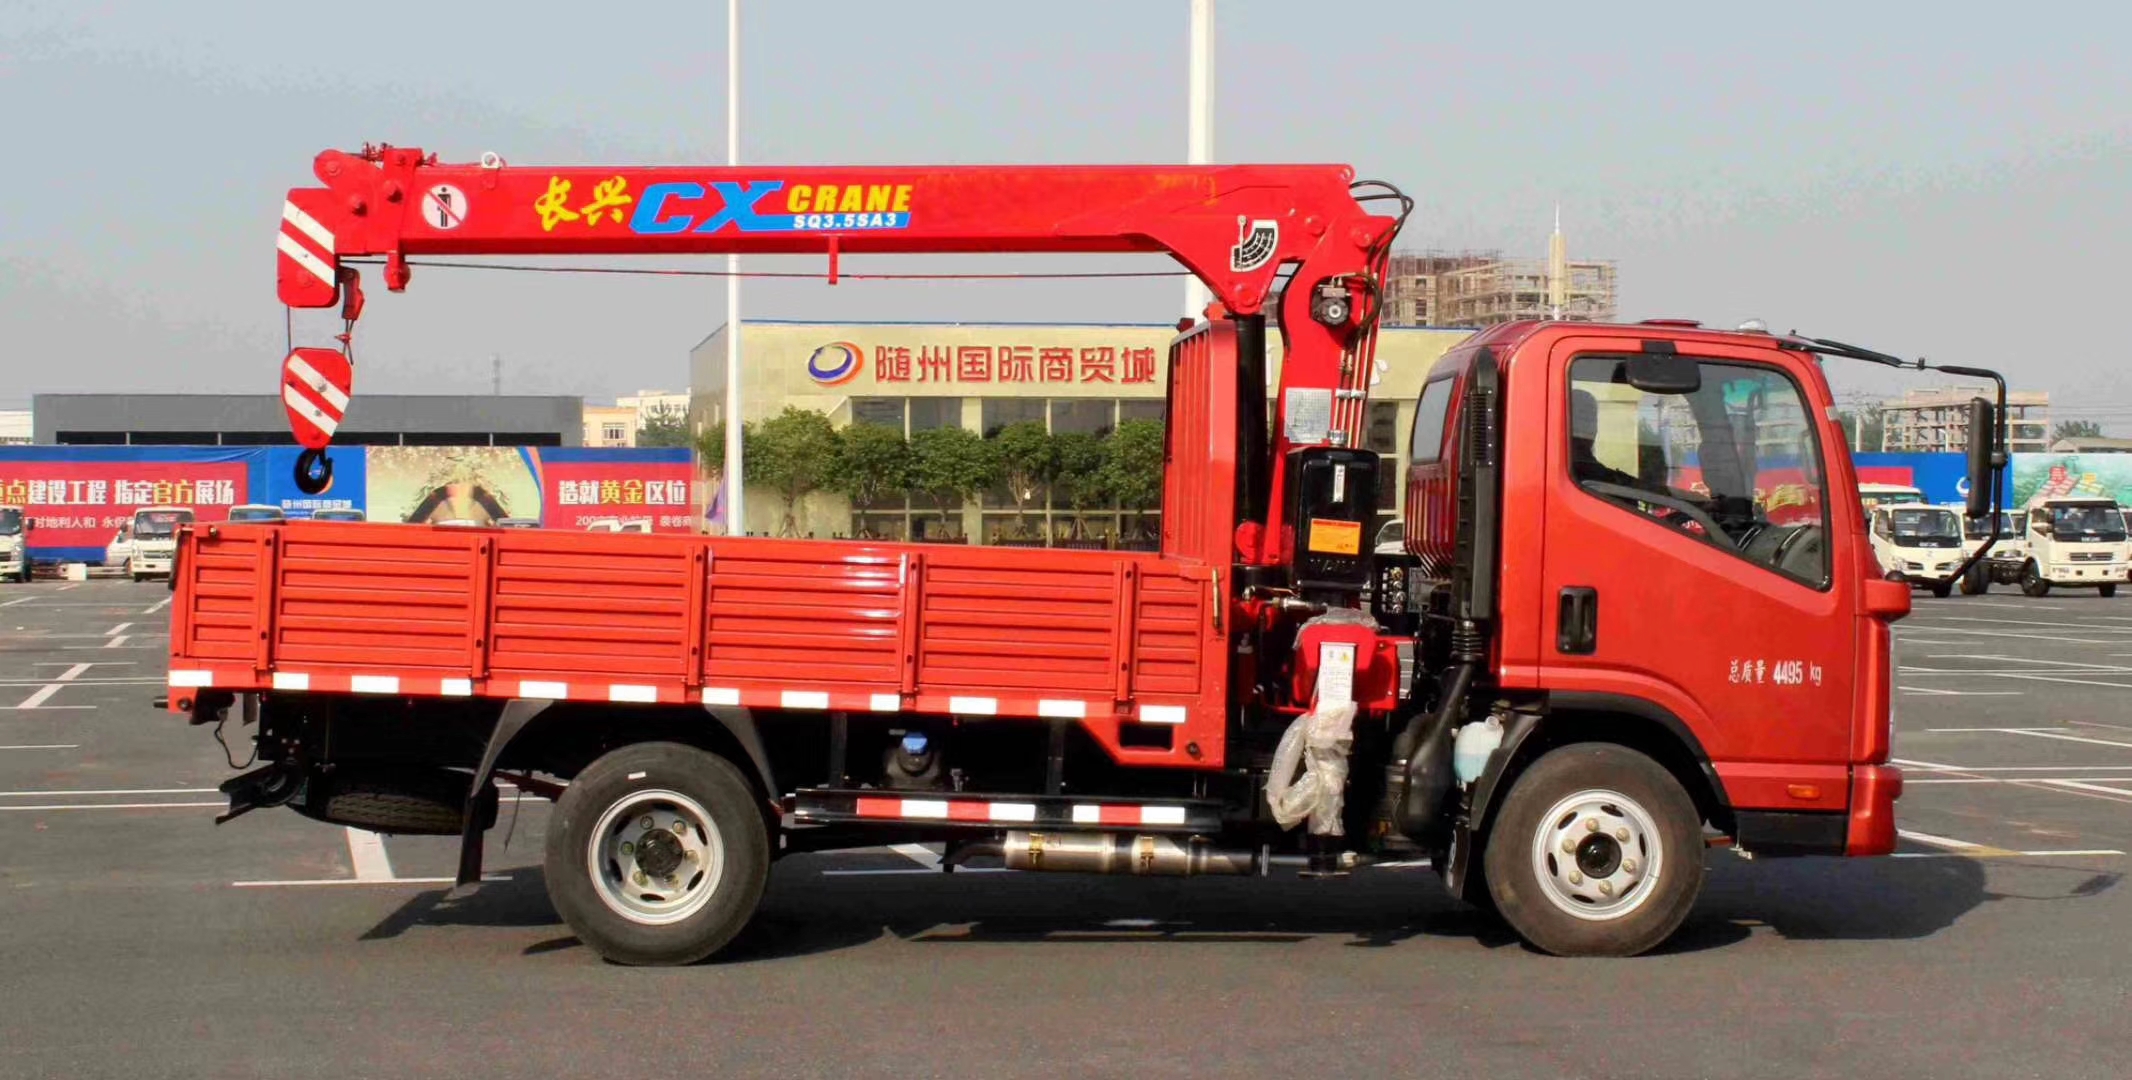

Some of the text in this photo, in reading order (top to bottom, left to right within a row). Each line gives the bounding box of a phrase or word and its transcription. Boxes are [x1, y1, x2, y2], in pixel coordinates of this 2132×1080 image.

[534, 175, 632, 231] 长兴
[629, 180, 785, 234] CX
[787, 184, 913, 213] CRANE
[793, 212, 897, 229] SQ3.5SA3
[875, 345, 1156, 385] 随州国际商贸城
[0, 479, 234, 505] 点建设工程 指定官方展场
[558, 478, 686, 505] 造就黄金区位
[1728, 659, 1822, 687] 总质量 4495 kg
